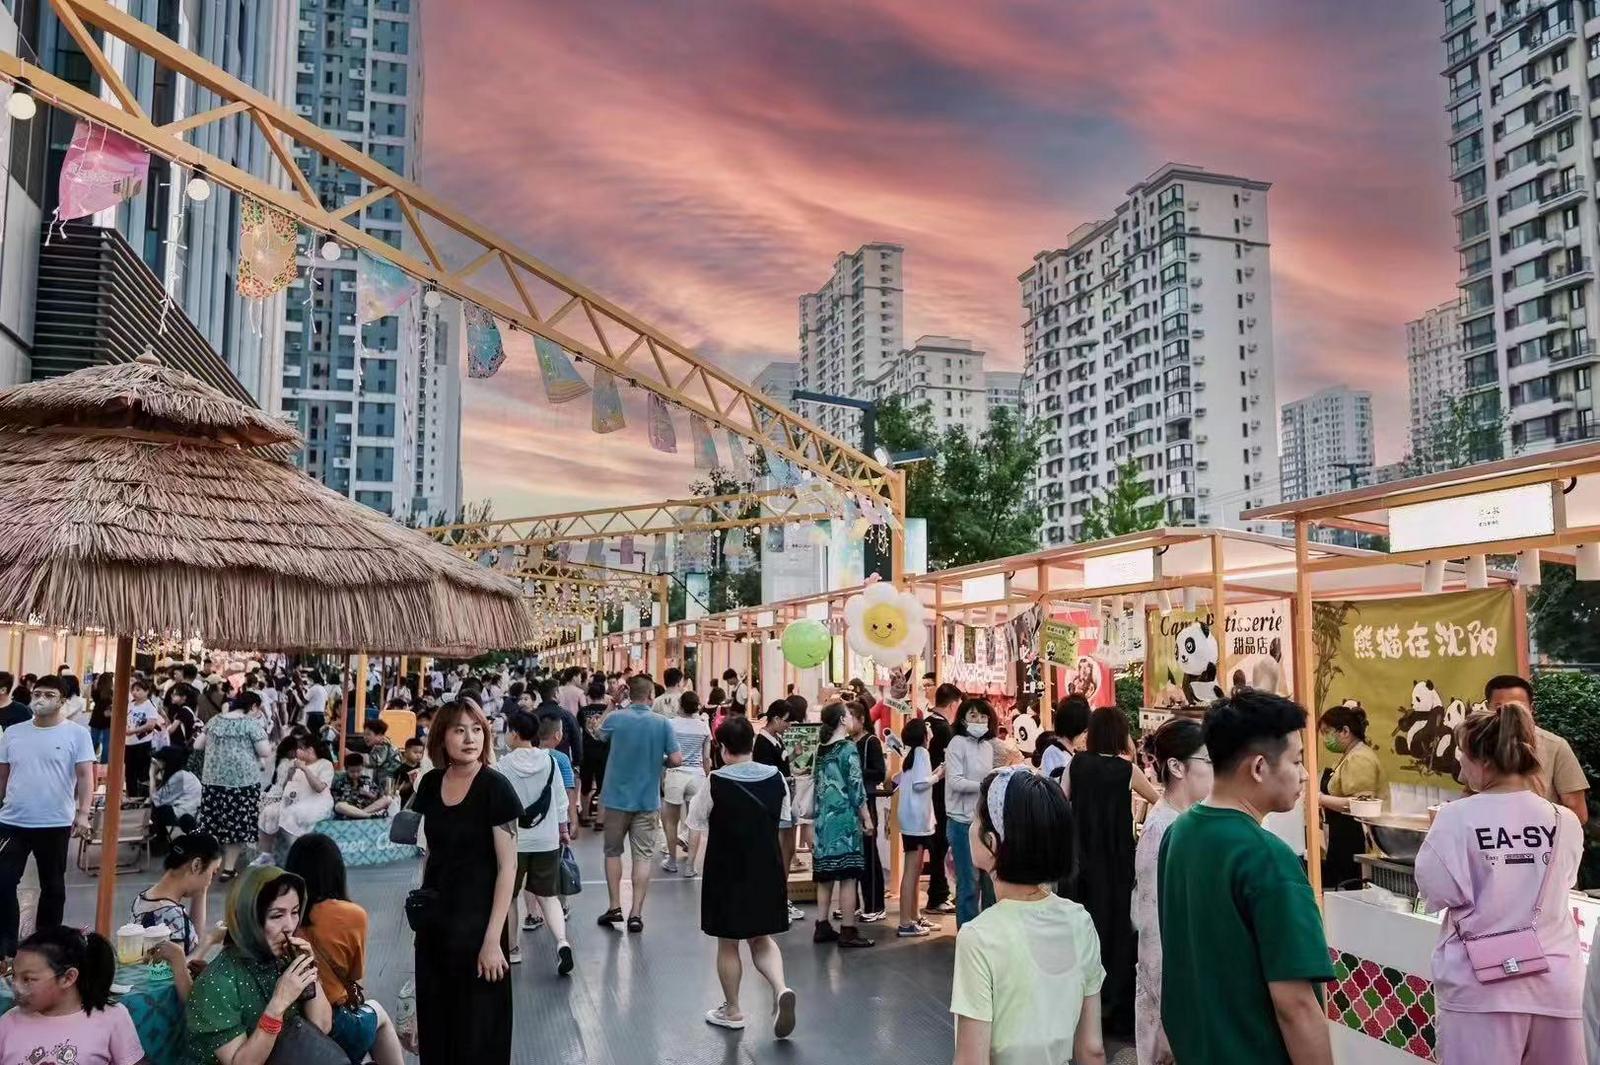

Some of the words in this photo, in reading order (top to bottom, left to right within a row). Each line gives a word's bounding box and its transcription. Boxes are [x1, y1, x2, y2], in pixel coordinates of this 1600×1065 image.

[1233, 636, 1268, 655] 甜品店
[1353, 620, 1498, 659] 熊猫在沈阳
[1475, 826, 1557, 850] EA-SY
